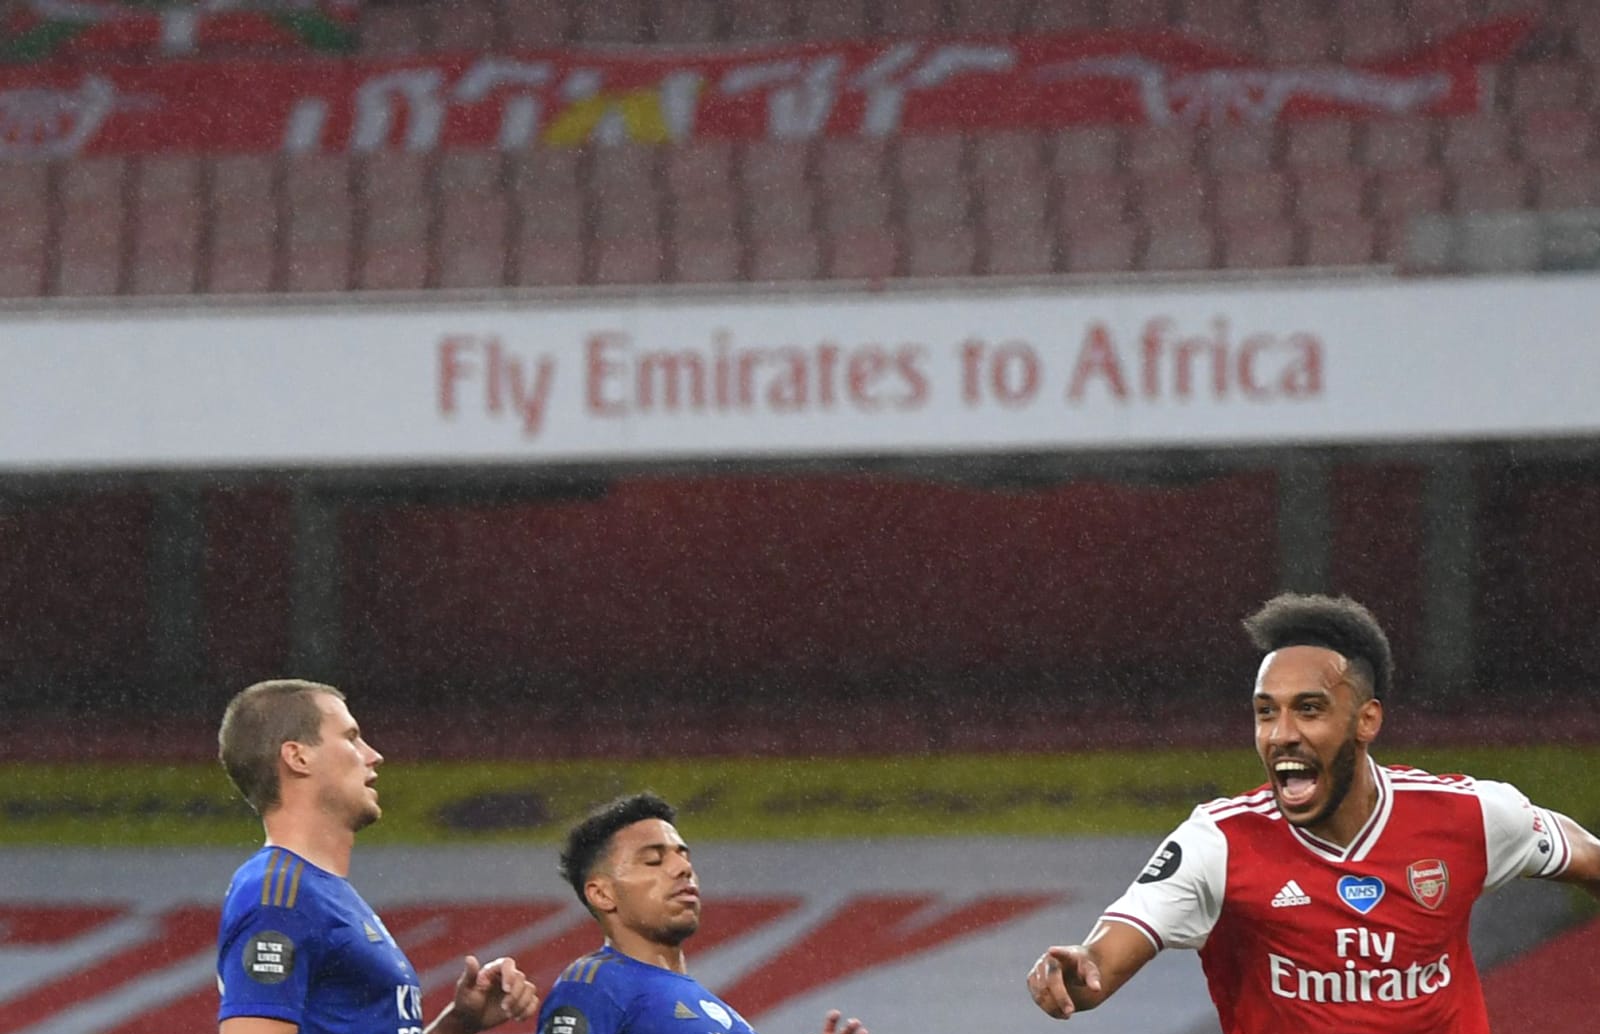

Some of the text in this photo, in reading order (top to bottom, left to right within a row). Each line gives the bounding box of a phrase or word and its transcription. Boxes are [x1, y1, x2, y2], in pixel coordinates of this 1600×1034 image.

[437, 317, 1326, 437] Fly Emirates to Africa
[1347, 886, 1375, 898] NHS
[1335, 927, 1396, 962] Fly
[1268, 953, 1451, 1003] Emirates
